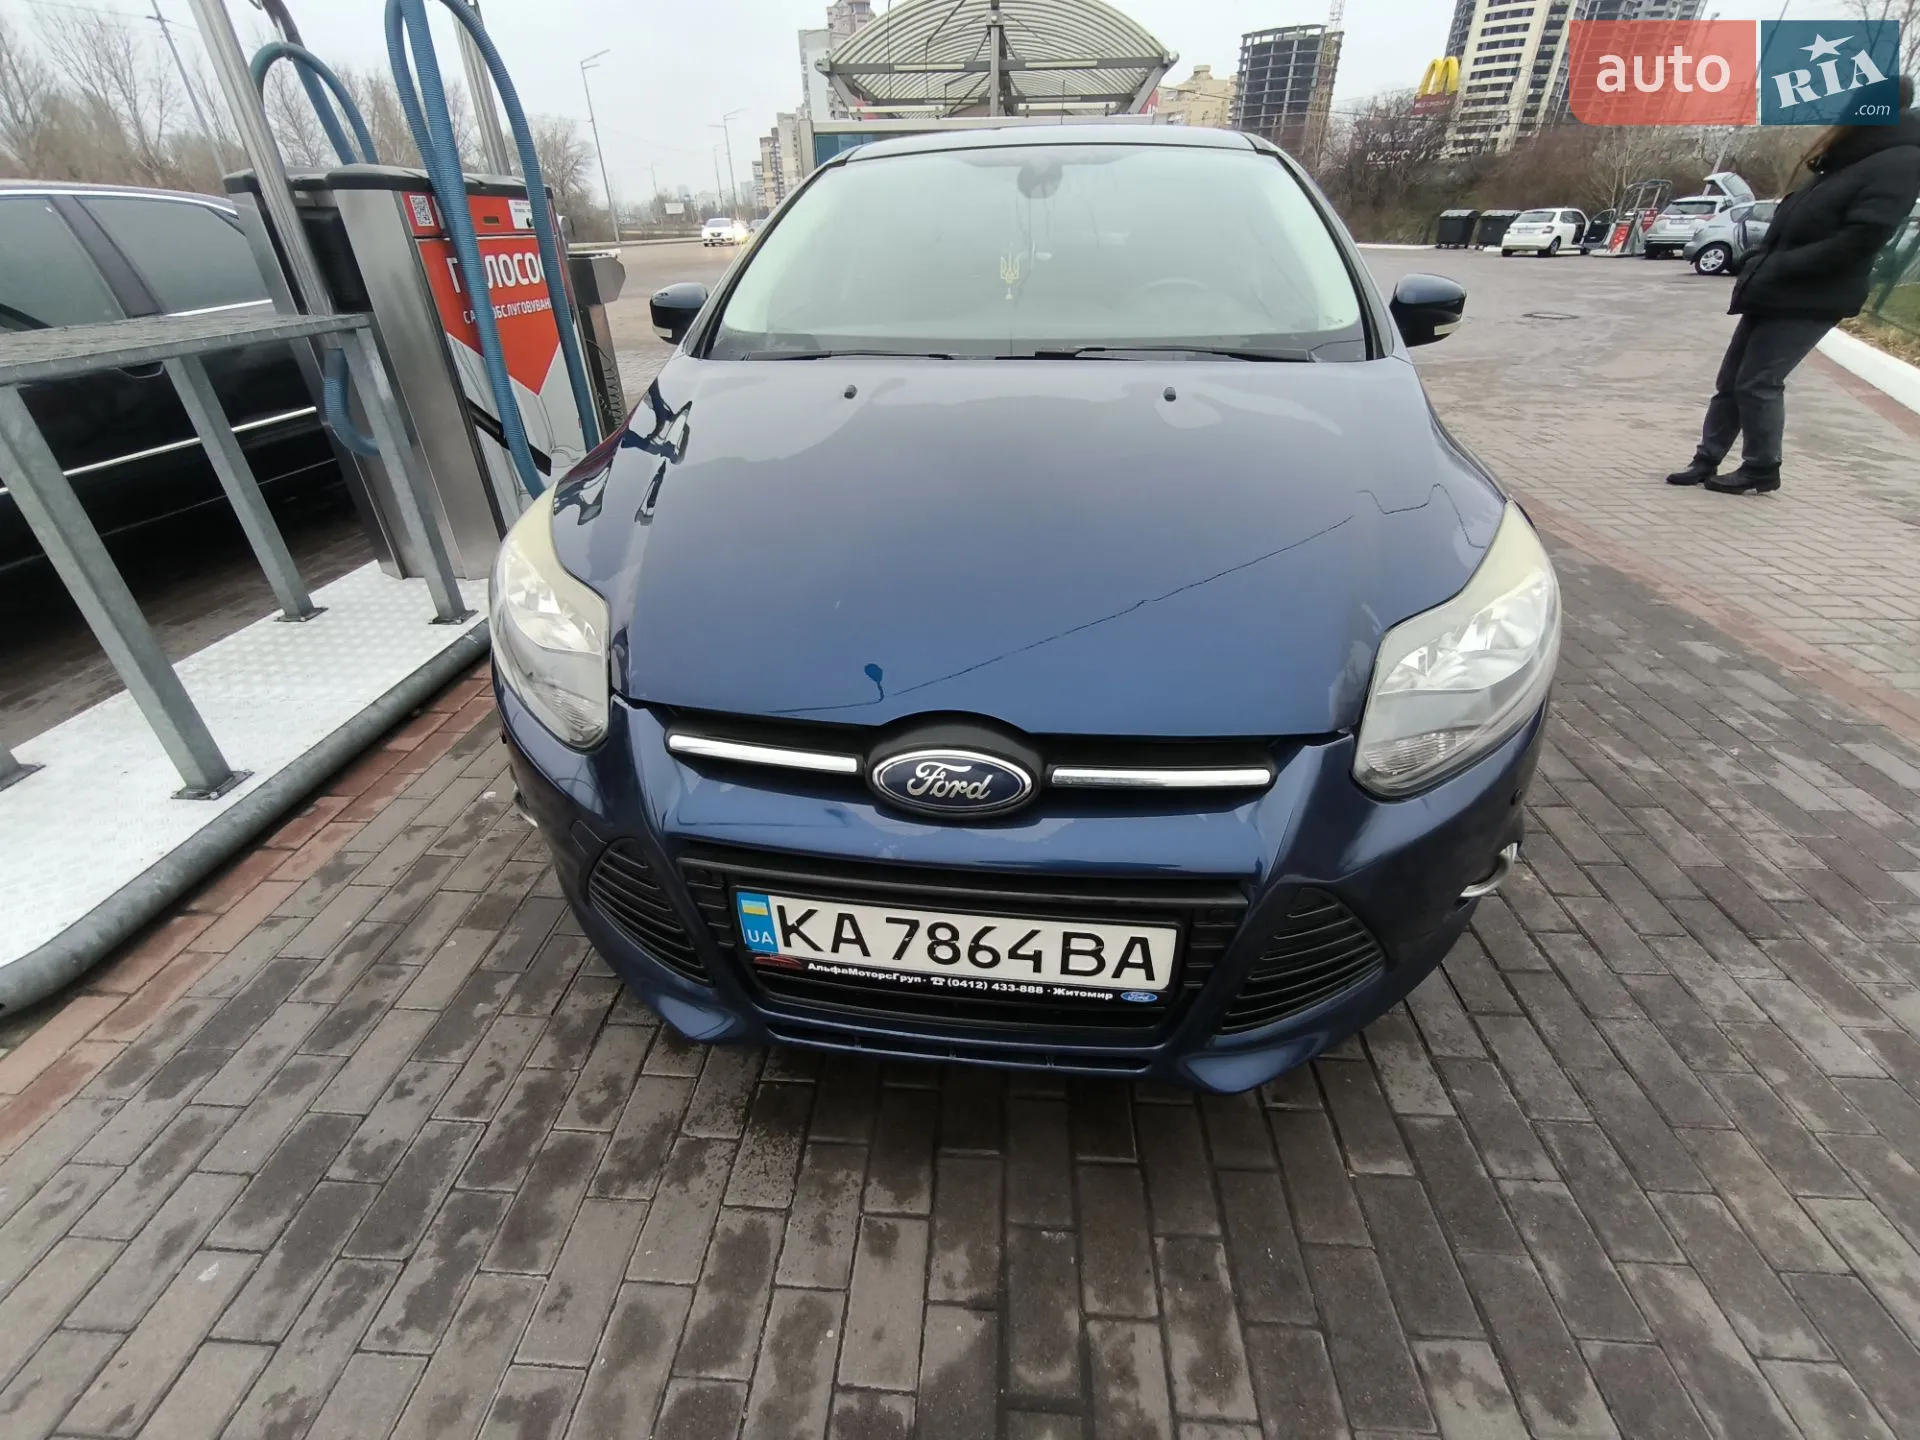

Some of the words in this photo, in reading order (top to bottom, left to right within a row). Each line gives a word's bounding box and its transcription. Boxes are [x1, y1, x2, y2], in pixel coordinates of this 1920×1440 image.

[906, 761, 993, 800] Ford
[747, 929, 774, 945] UA
[776, 904, 872, 958] KA
[885, 917, 1043, 974] 7864
[1060, 931, 1156, 981] BA
[947, 978, 988, 990] (0412)
[991, 983, 1044, 994] 433-888
[1053, 987, 1114, 1000] Житомир
